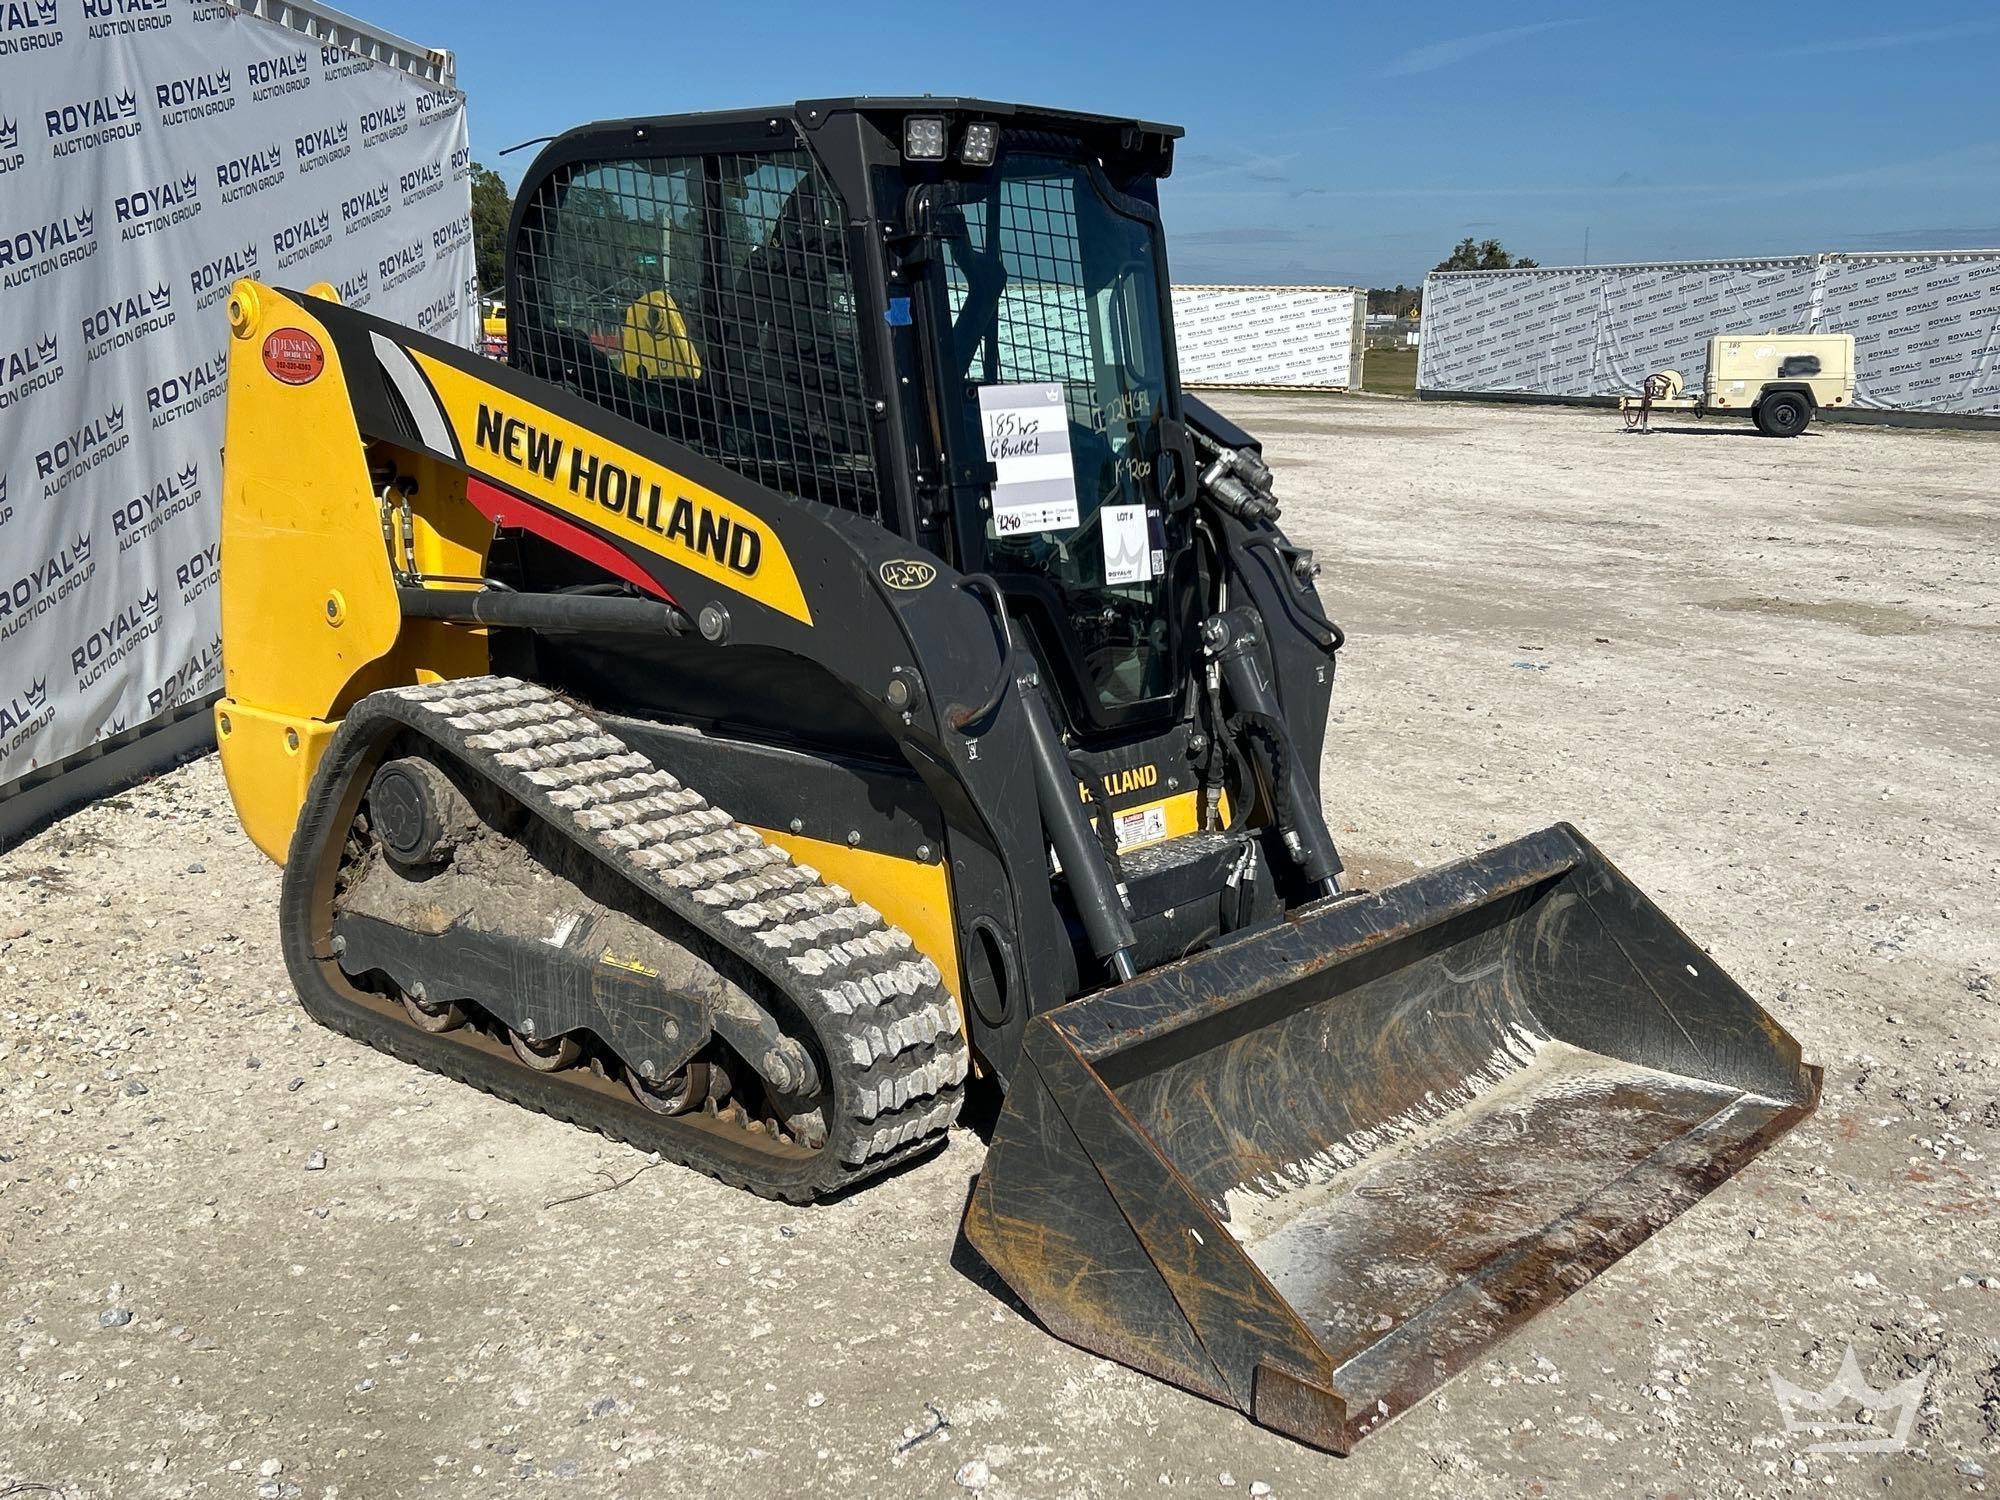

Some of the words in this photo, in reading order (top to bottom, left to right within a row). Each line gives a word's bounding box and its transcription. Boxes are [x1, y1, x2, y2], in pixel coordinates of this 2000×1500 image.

[89, 20, 135, 39] AUCTION
[138, 15, 172, 31] GROUP
[193, 7, 230, 23] AUCTION
[21, 31, 63, 52] GROUP
[248, 55, 297, 86] ROYAL
[324, 66, 352, 82] AUCTION
[156, 74, 218, 109] ROYAL
[252, 84, 285, 103] AUCTION
[286, 77, 310, 93] GROUP
[416, 90, 449, 114] ROYAL
[45, 97, 118, 138] ROYAL
[162, 106, 204, 127] AUCTION
[206, 97, 236, 116] GROUP
[360, 107, 398, 134] ROYAL
[419, 112, 442, 127] AUCTION
[53, 132, 100, 158] AUCTION
[102, 122, 142, 143] GROUP
[295, 126, 339, 158] ROYAL
[363, 131, 389, 149] AUCTION
[389, 124, 409, 139] GROUP
[0, 154, 24, 174] OUP
[216, 151, 270, 188] ROYAL
[299, 155, 329, 175] AUCTION
[329, 145, 351, 161] GROUP
[451, 147, 469, 170] ROY
[222, 182, 258, 205] AUCTION
[259, 171, 285, 191] GROUP
[400, 164, 434, 193] ROYAL
[114, 181, 184, 223] ROYAL
[342, 188, 380, 222] ROYAL
[403, 189, 426, 208] AUCTION
[122, 214, 171, 243] AUCTION
[172, 202, 201, 225] GROUP
[345, 215, 371, 236] AUCTION
[371, 205, 392, 223] GROUP
[433, 219, 463, 249] ROYAL
[0, 218, 78, 269] ROYAL
[274, 217, 320, 254] ROYAL
[4, 256, 59, 290] AUCTION
[60, 240, 98, 267] GROUP
[278, 247, 309, 270] AUCTION
[310, 234, 333, 254] GROUP
[379, 246, 416, 279] ROYAL
[190, 251, 245, 295] ROYAL
[1866, 274, 1890, 284] ROYAL
[1905, 264, 1929, 274] ROYAL
[1927, 278, 1951, 288] ROYAL
[1969, 267, 1994, 277] ROYAL
[196, 284, 231, 312] AUCTION
[336, 278, 360, 301] YAL
[1849, 298, 1871, 307] ROYAL
[1886, 288, 1911, 298] ROYAL
[1946, 292, 1972, 302] ROYAL
[82, 294, 151, 344] ROYAL
[418, 296, 449, 329] ROYAL
[1867, 312, 1891, 322] ROYAL
[1906, 302, 1931, 312] ROYAL
[1970, 306, 1995, 316] ROYAL
[1888, 325, 1912, 335] ROYAL
[1928, 317, 1954, 326] ROYAL
[87, 328, 135, 364] AUCTION
[135, 312, 176, 339] GROUP
[1855, 334, 1873, 343] OYAL
[1908, 340, 1932, 350] ROYAL
[1948, 331, 1973, 341] ROYAL
[1868, 349, 1892, 358] ROYAL
[1930, 355, 1954, 364] ROYAL
[1972, 346, 1997, 356] ROYAL
[1889, 363, 1914, 372] ROYAL
[1949, 370, 1974, 379] ROYAL
[20, 366, 64, 398] GROUP
[146, 362, 216, 413] ROYAL
[1869, 386, 1893, 395] ROYAL
[1909, 378, 1933, 388] ROYAL
[1973, 386, 1998, 394] ROYAL
[152, 396, 202, 430] AUCTION
[202, 378, 228, 404] GROU
[1892, 401, 1916, 409] ROYAL
[1931, 394, 1956, 402] ROYAL
[990, 413, 1016, 438] 185
[1019, 416, 1039, 435] hrs
[35, 419, 109, 480] ROYAL
[43, 459, 92, 500] AUCTION
[92, 434, 130, 467] GROUP
[476, 401, 564, 484] NEW
[569, 446, 764, 579] HOLLAND
[112, 477, 180, 536] ROYAL
[1117, 512, 1128, 522] LOT
[119, 512, 164, 554] AUCTION
[164, 489, 202, 521] GROUP
[176, 543, 221, 590] ROY
[885, 566, 928, 589] 4290
[0, 551, 74, 621] ROYAL
[1, 595, 57, 642] AUCTION
[58, 562, 96, 600] GROUP
[71, 605, 142, 676] ROYAL
[79, 643, 127, 694] AUCTION
[126, 614, 163, 652] GROUP
[147, 648, 213, 715] ROYAL
[197, 663, 222, 692] GROU
[12, 705, 56, 751] GROUP
[1078, 764, 1158, 804] HLLAND
